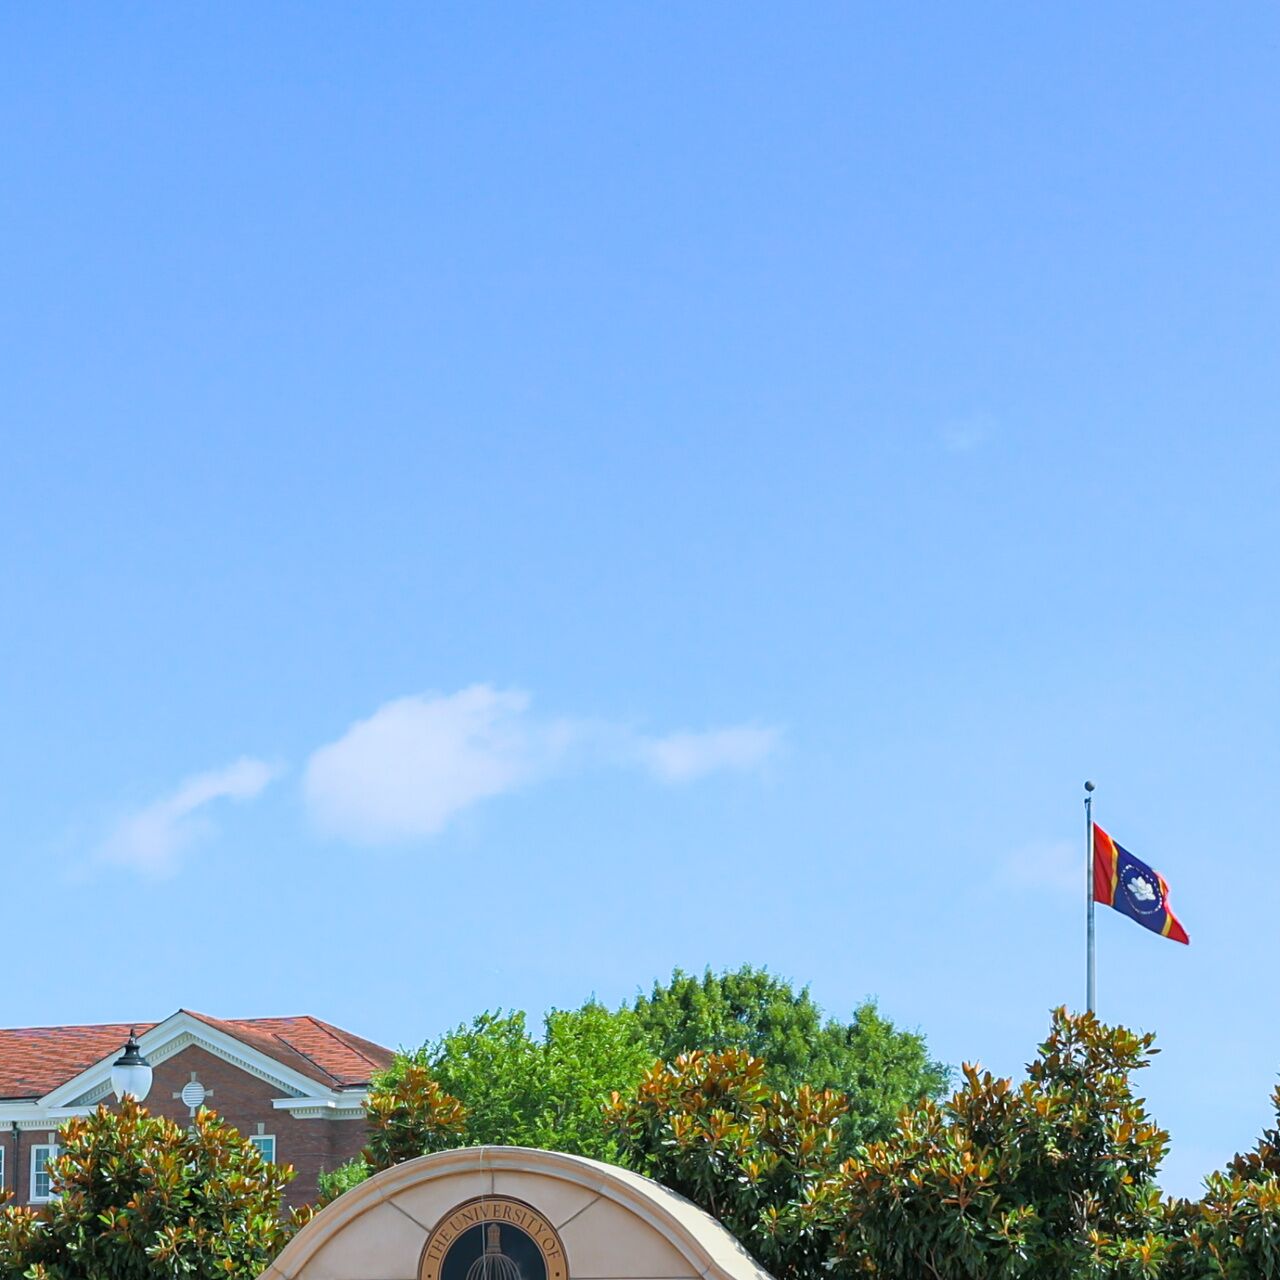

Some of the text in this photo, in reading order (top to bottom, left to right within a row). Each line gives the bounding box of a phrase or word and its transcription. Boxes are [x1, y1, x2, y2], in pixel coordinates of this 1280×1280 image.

[427, 1204, 561, 1262] THE UNIVERSITY OF
